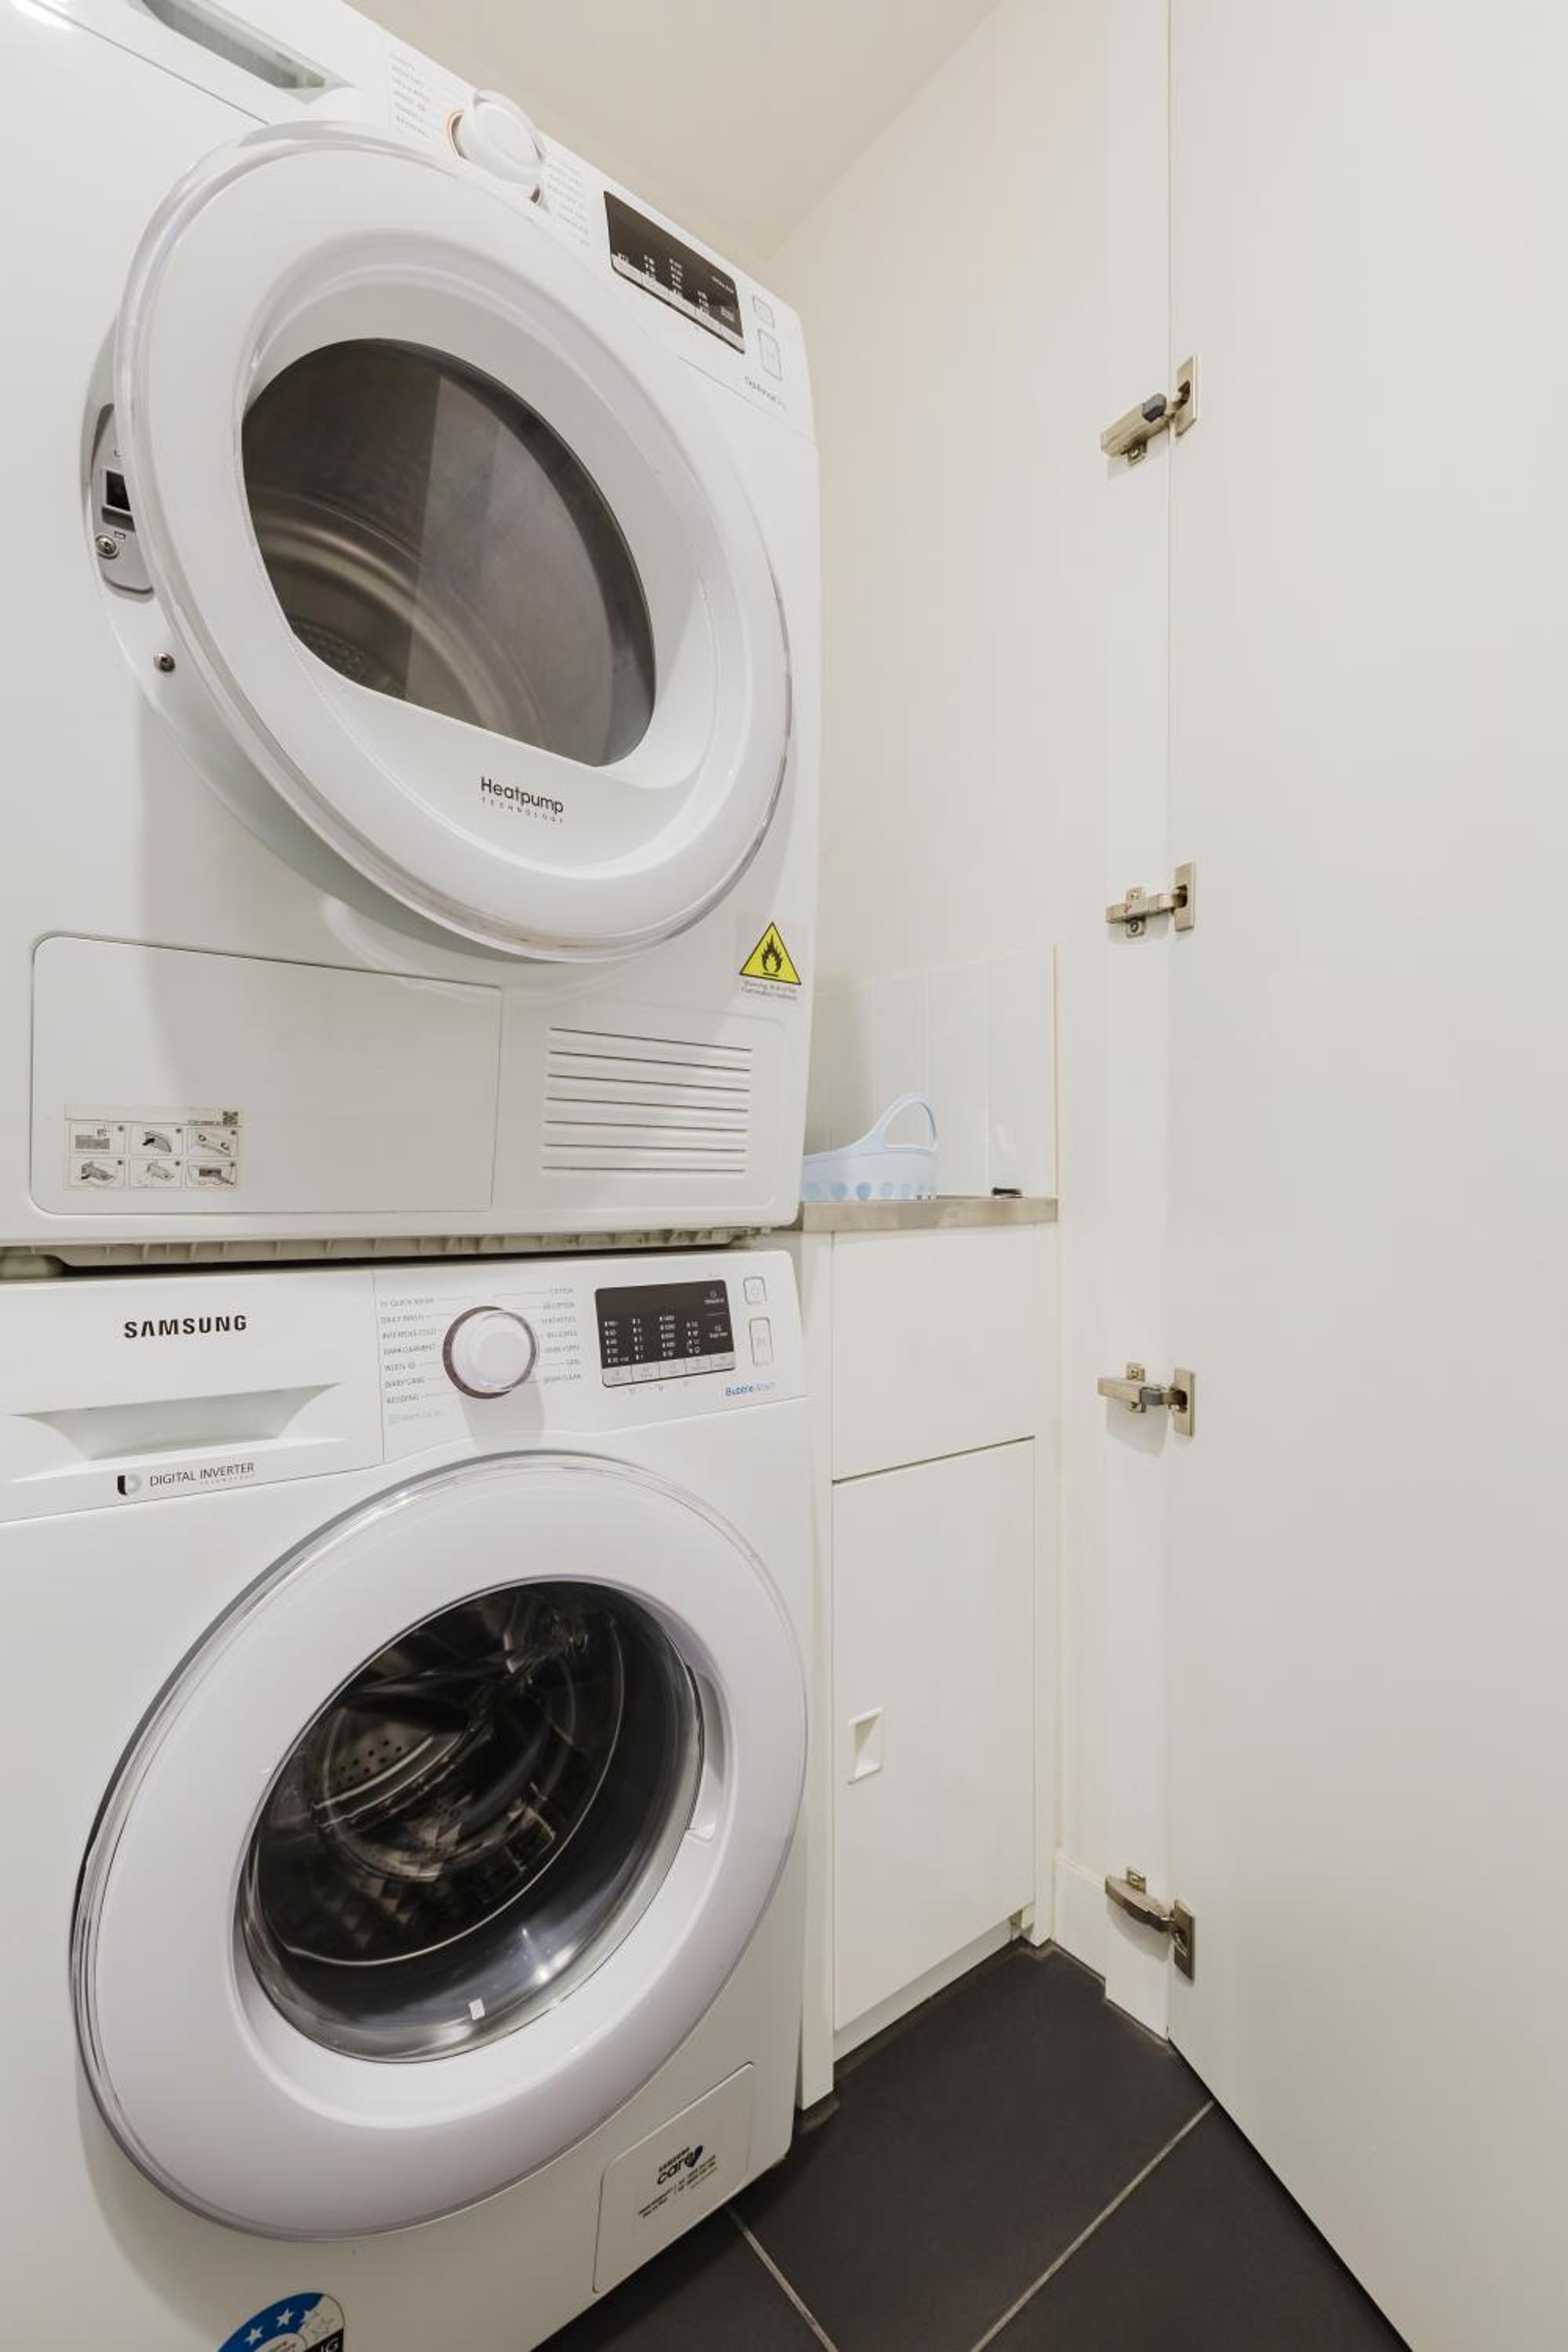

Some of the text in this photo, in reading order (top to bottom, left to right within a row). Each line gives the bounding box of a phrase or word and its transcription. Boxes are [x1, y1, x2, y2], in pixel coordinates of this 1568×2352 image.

[481, 776, 564, 815] Heatpump
[124, 1315, 247, 1338] SAMSUNG
[149, 1470, 196, 1487] DIGITAL
[199, 1462, 254, 1480] INVERTER
